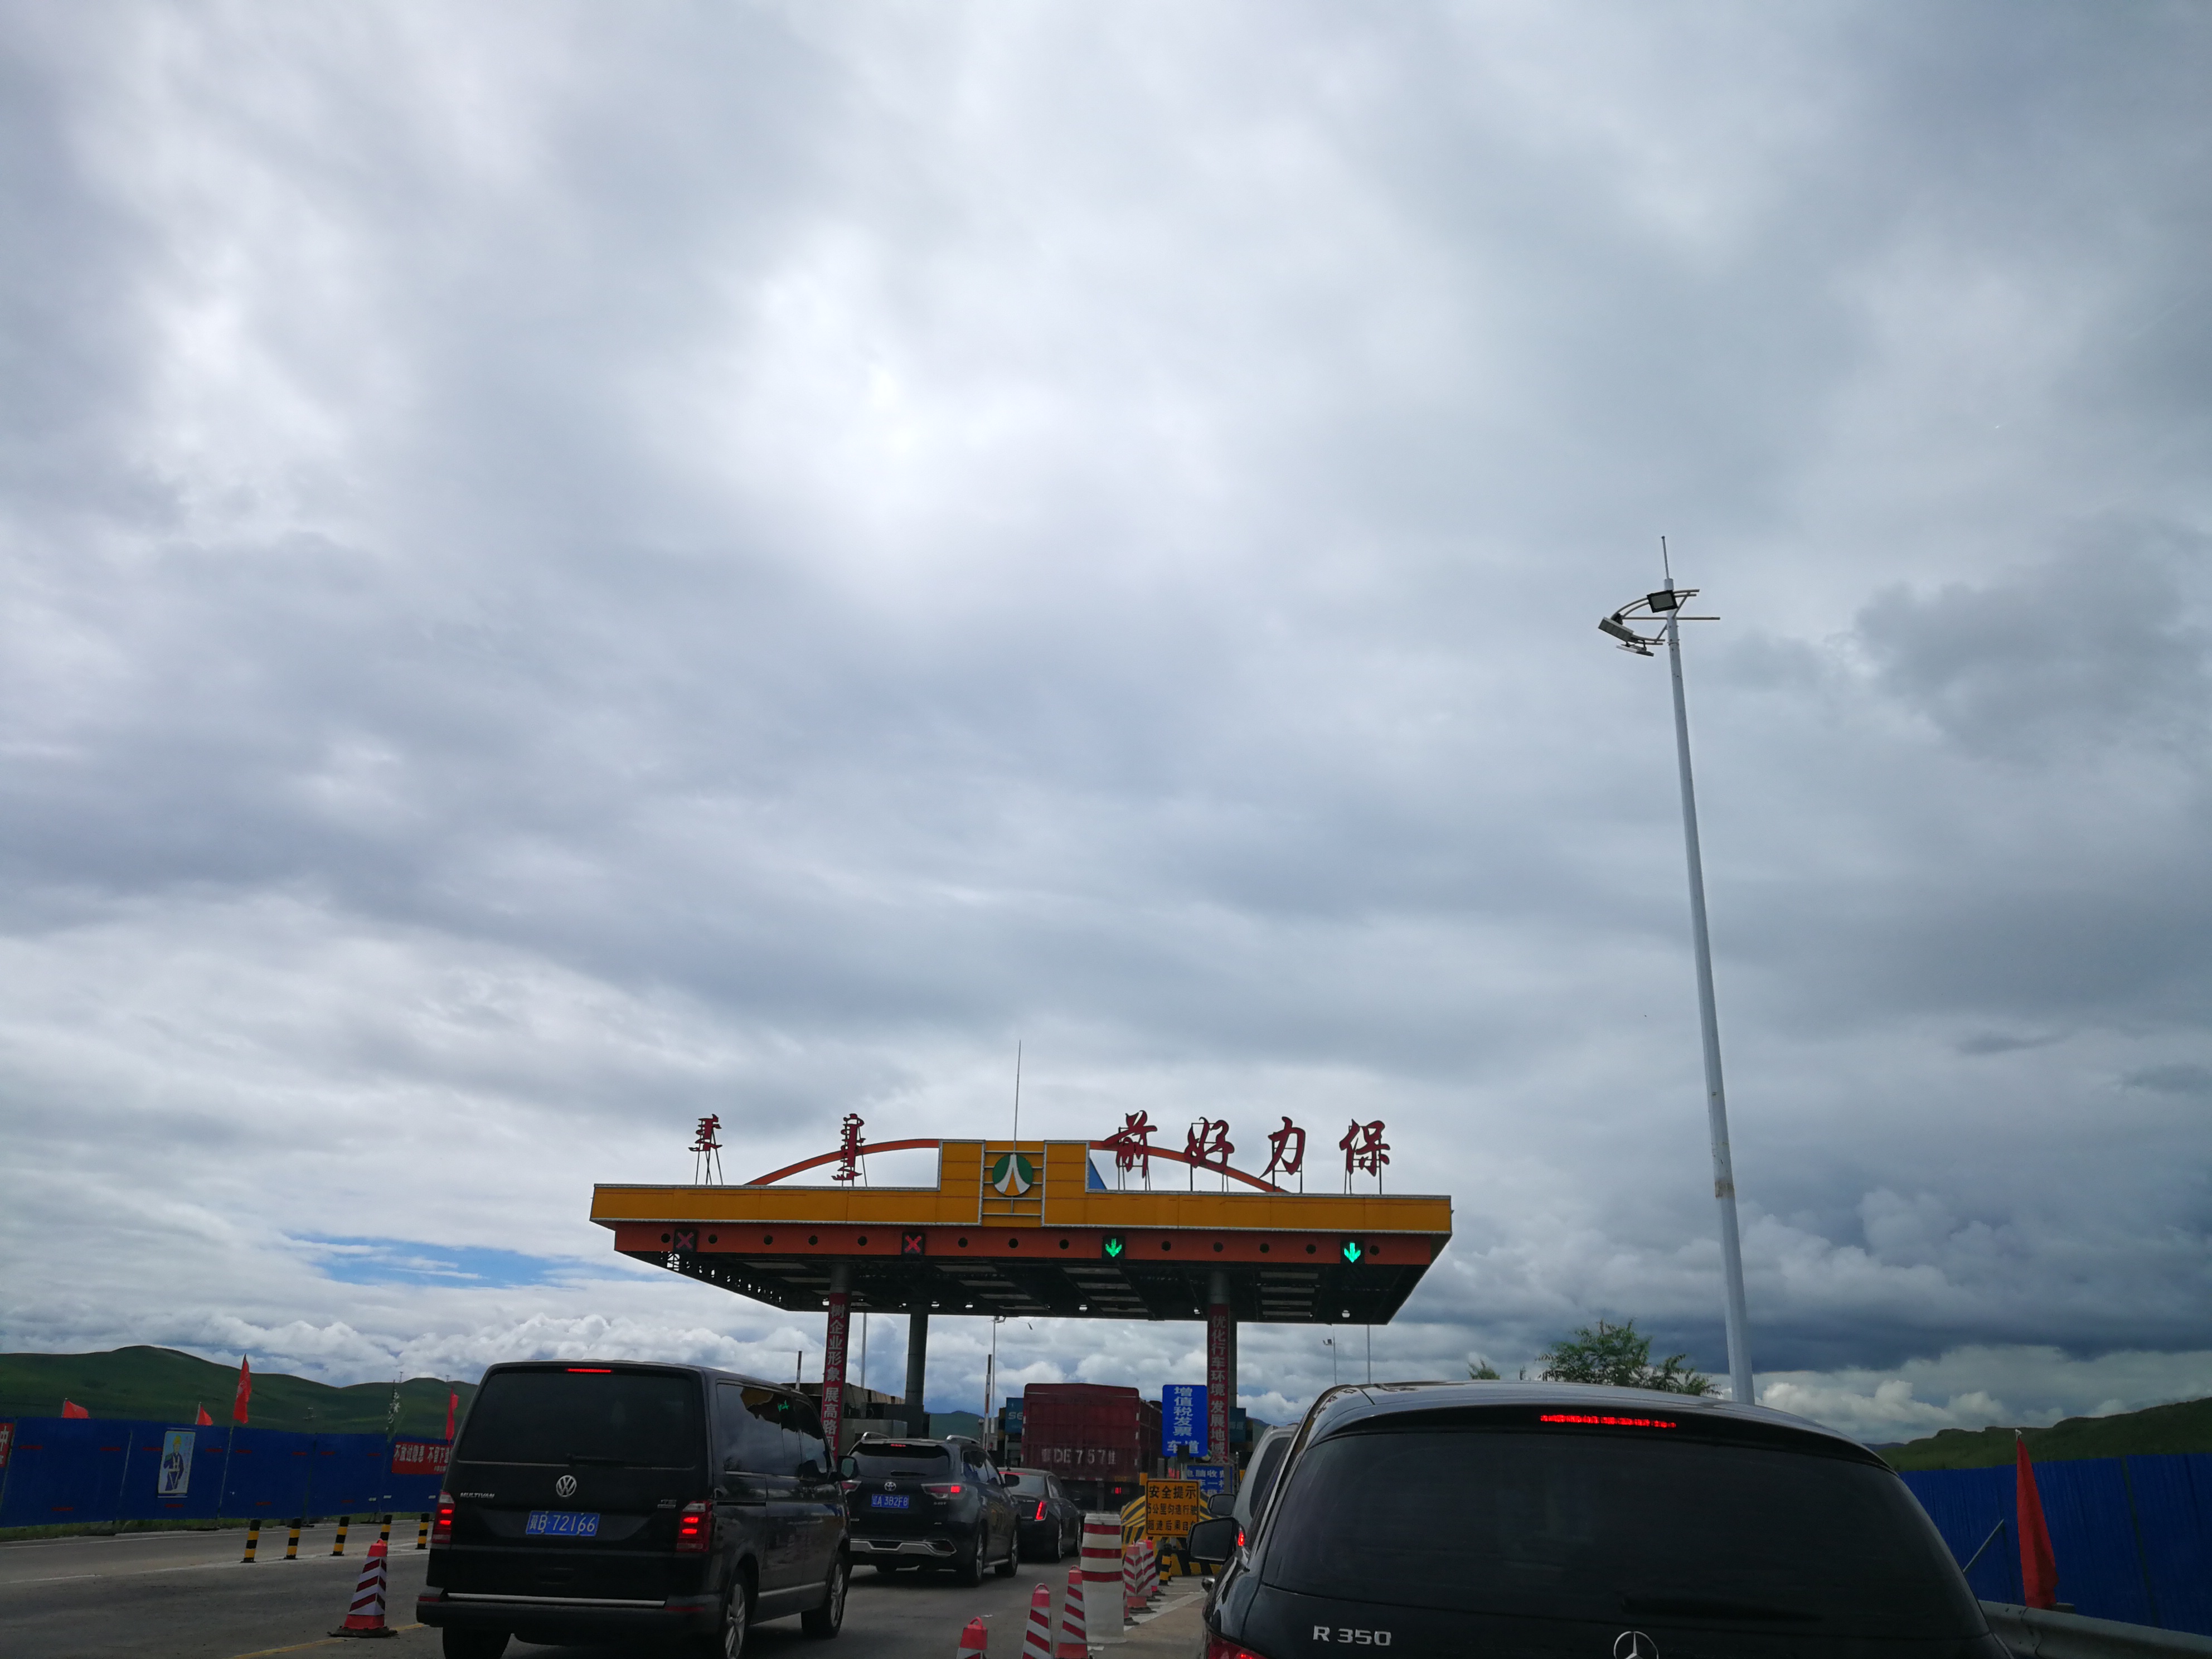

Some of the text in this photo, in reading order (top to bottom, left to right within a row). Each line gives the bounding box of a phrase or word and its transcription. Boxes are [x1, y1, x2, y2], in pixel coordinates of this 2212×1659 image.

[1210, 1315, 1226, 1396] 优化行车环境
[1172, 1386, 1193, 1437] 增值税发票
[1149, 1485, 1196, 1500] 安全提示
[1313, 1625, 1392, 1646] R 350
